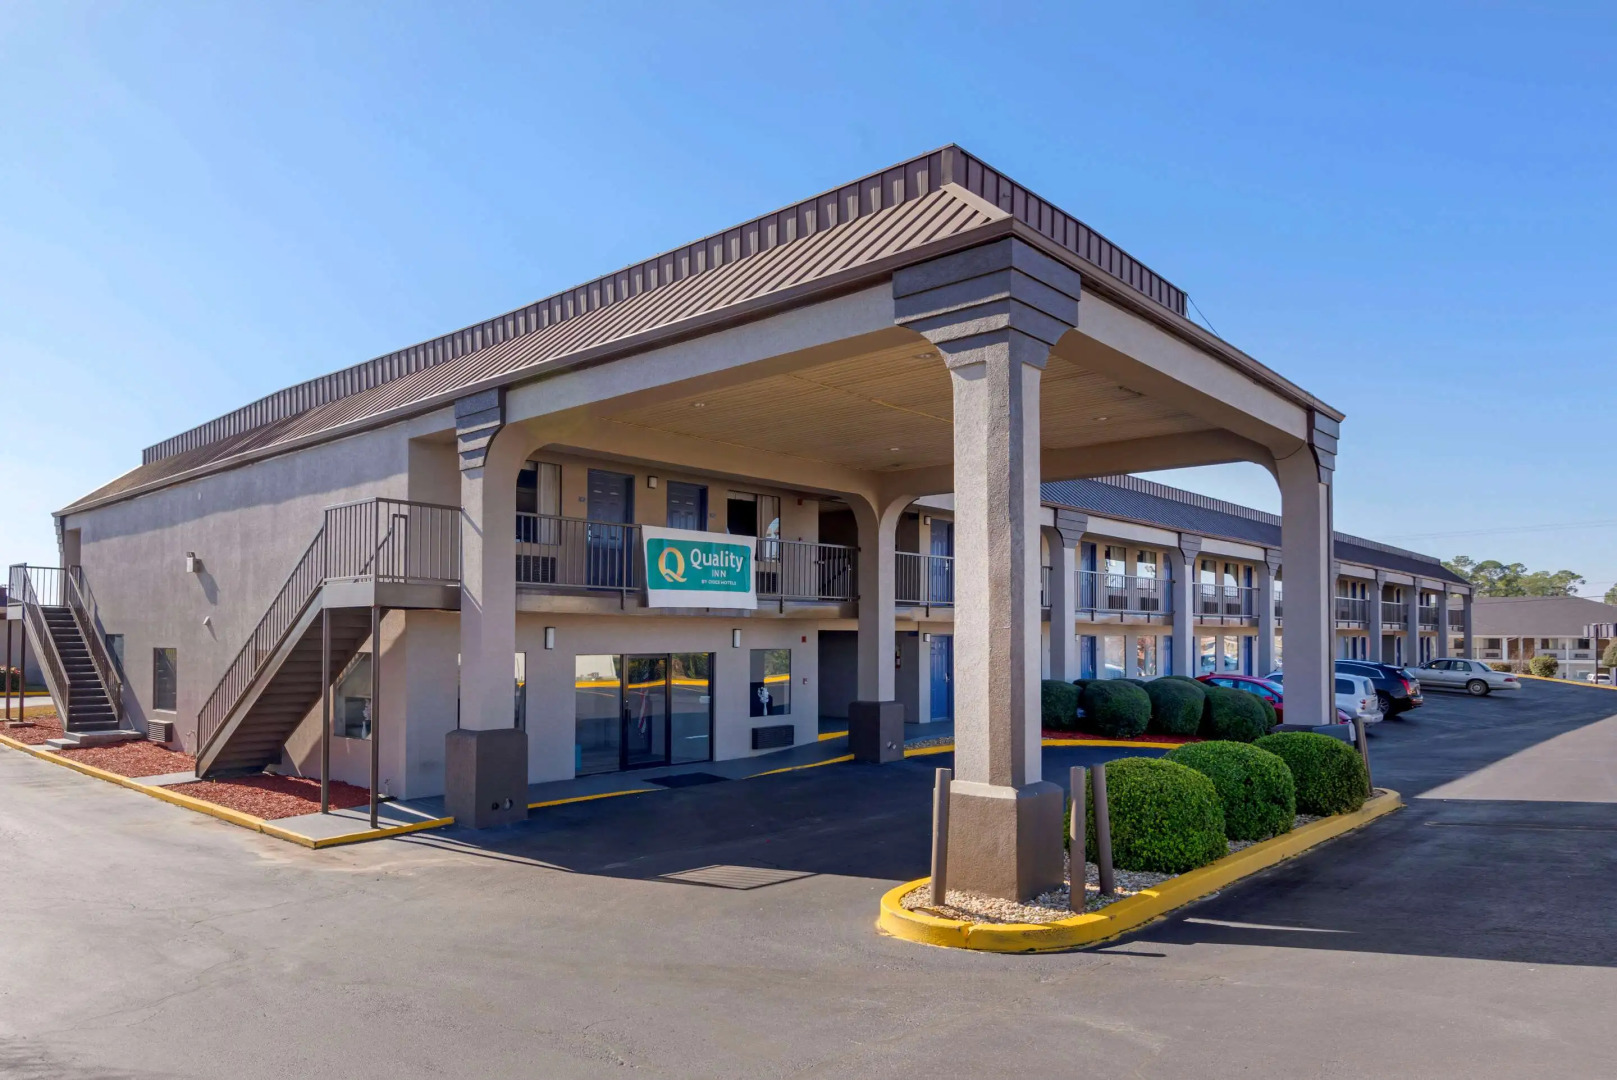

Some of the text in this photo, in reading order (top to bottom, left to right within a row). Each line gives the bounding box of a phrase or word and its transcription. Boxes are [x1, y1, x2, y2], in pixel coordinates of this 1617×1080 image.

[658, 547, 688, 583] Q
[690, 548, 744, 573] Quality
[711, 569, 727, 578] INN
